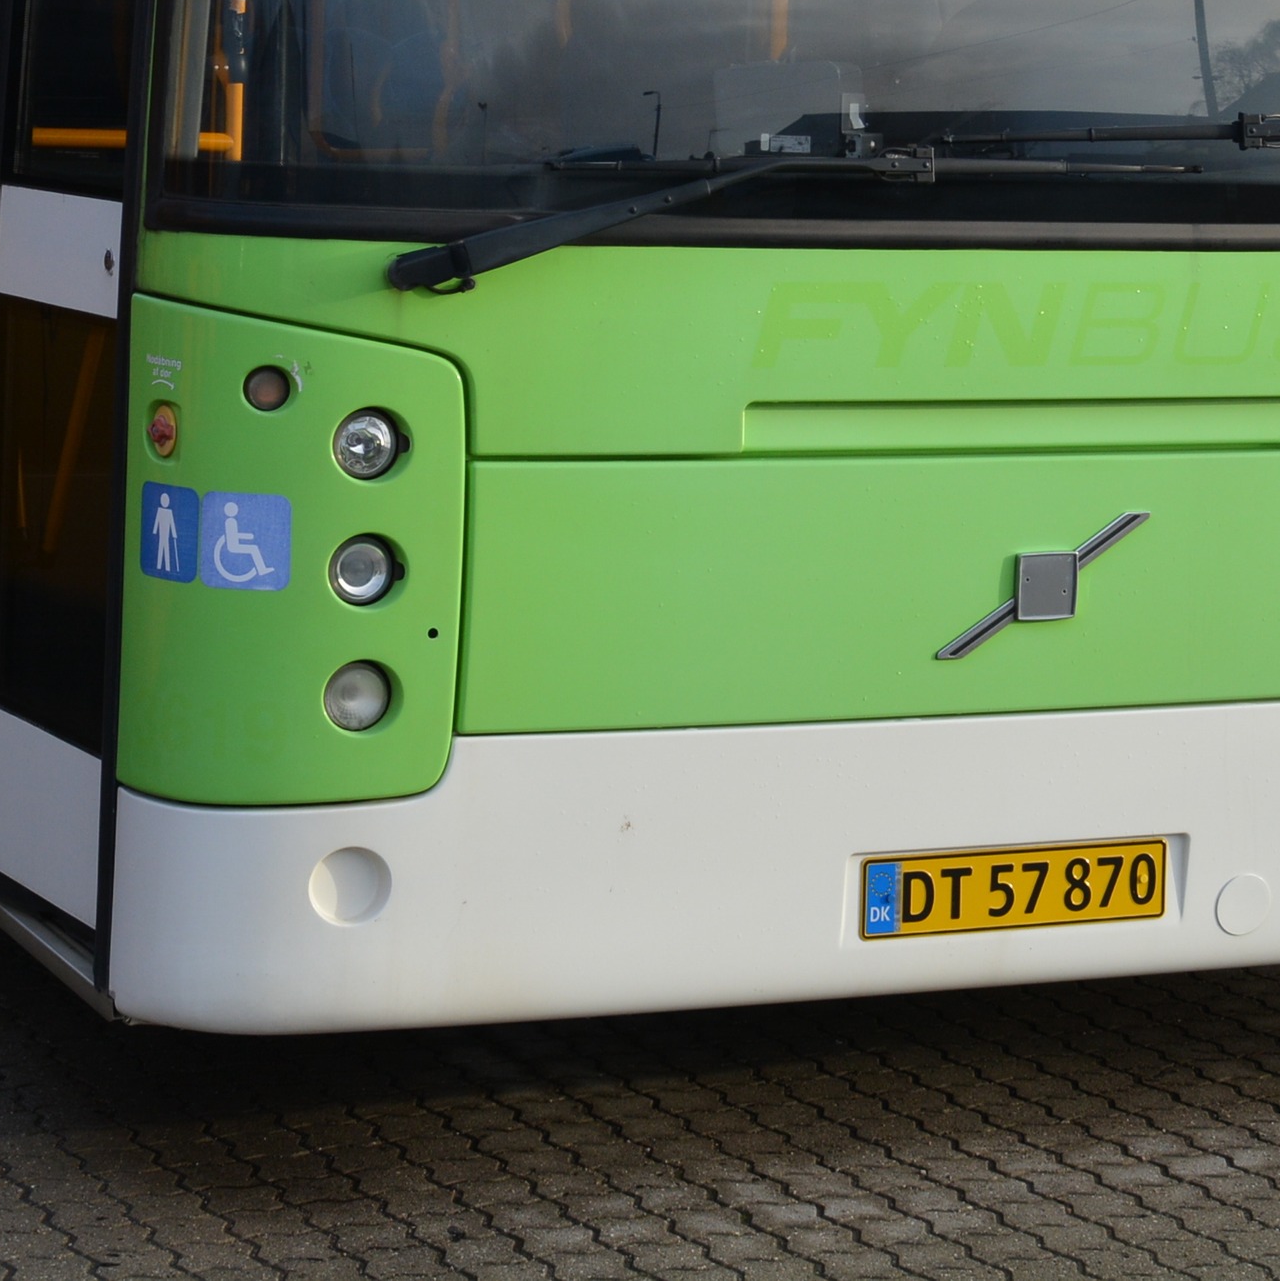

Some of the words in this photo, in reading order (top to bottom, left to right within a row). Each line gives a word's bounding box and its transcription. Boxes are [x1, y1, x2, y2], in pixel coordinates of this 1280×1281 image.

[869, 905, 891, 923] DK
[901, 866, 973, 924] DT
[988, 860, 1050, 918] 57
[1063, 852, 1157, 912] 870
